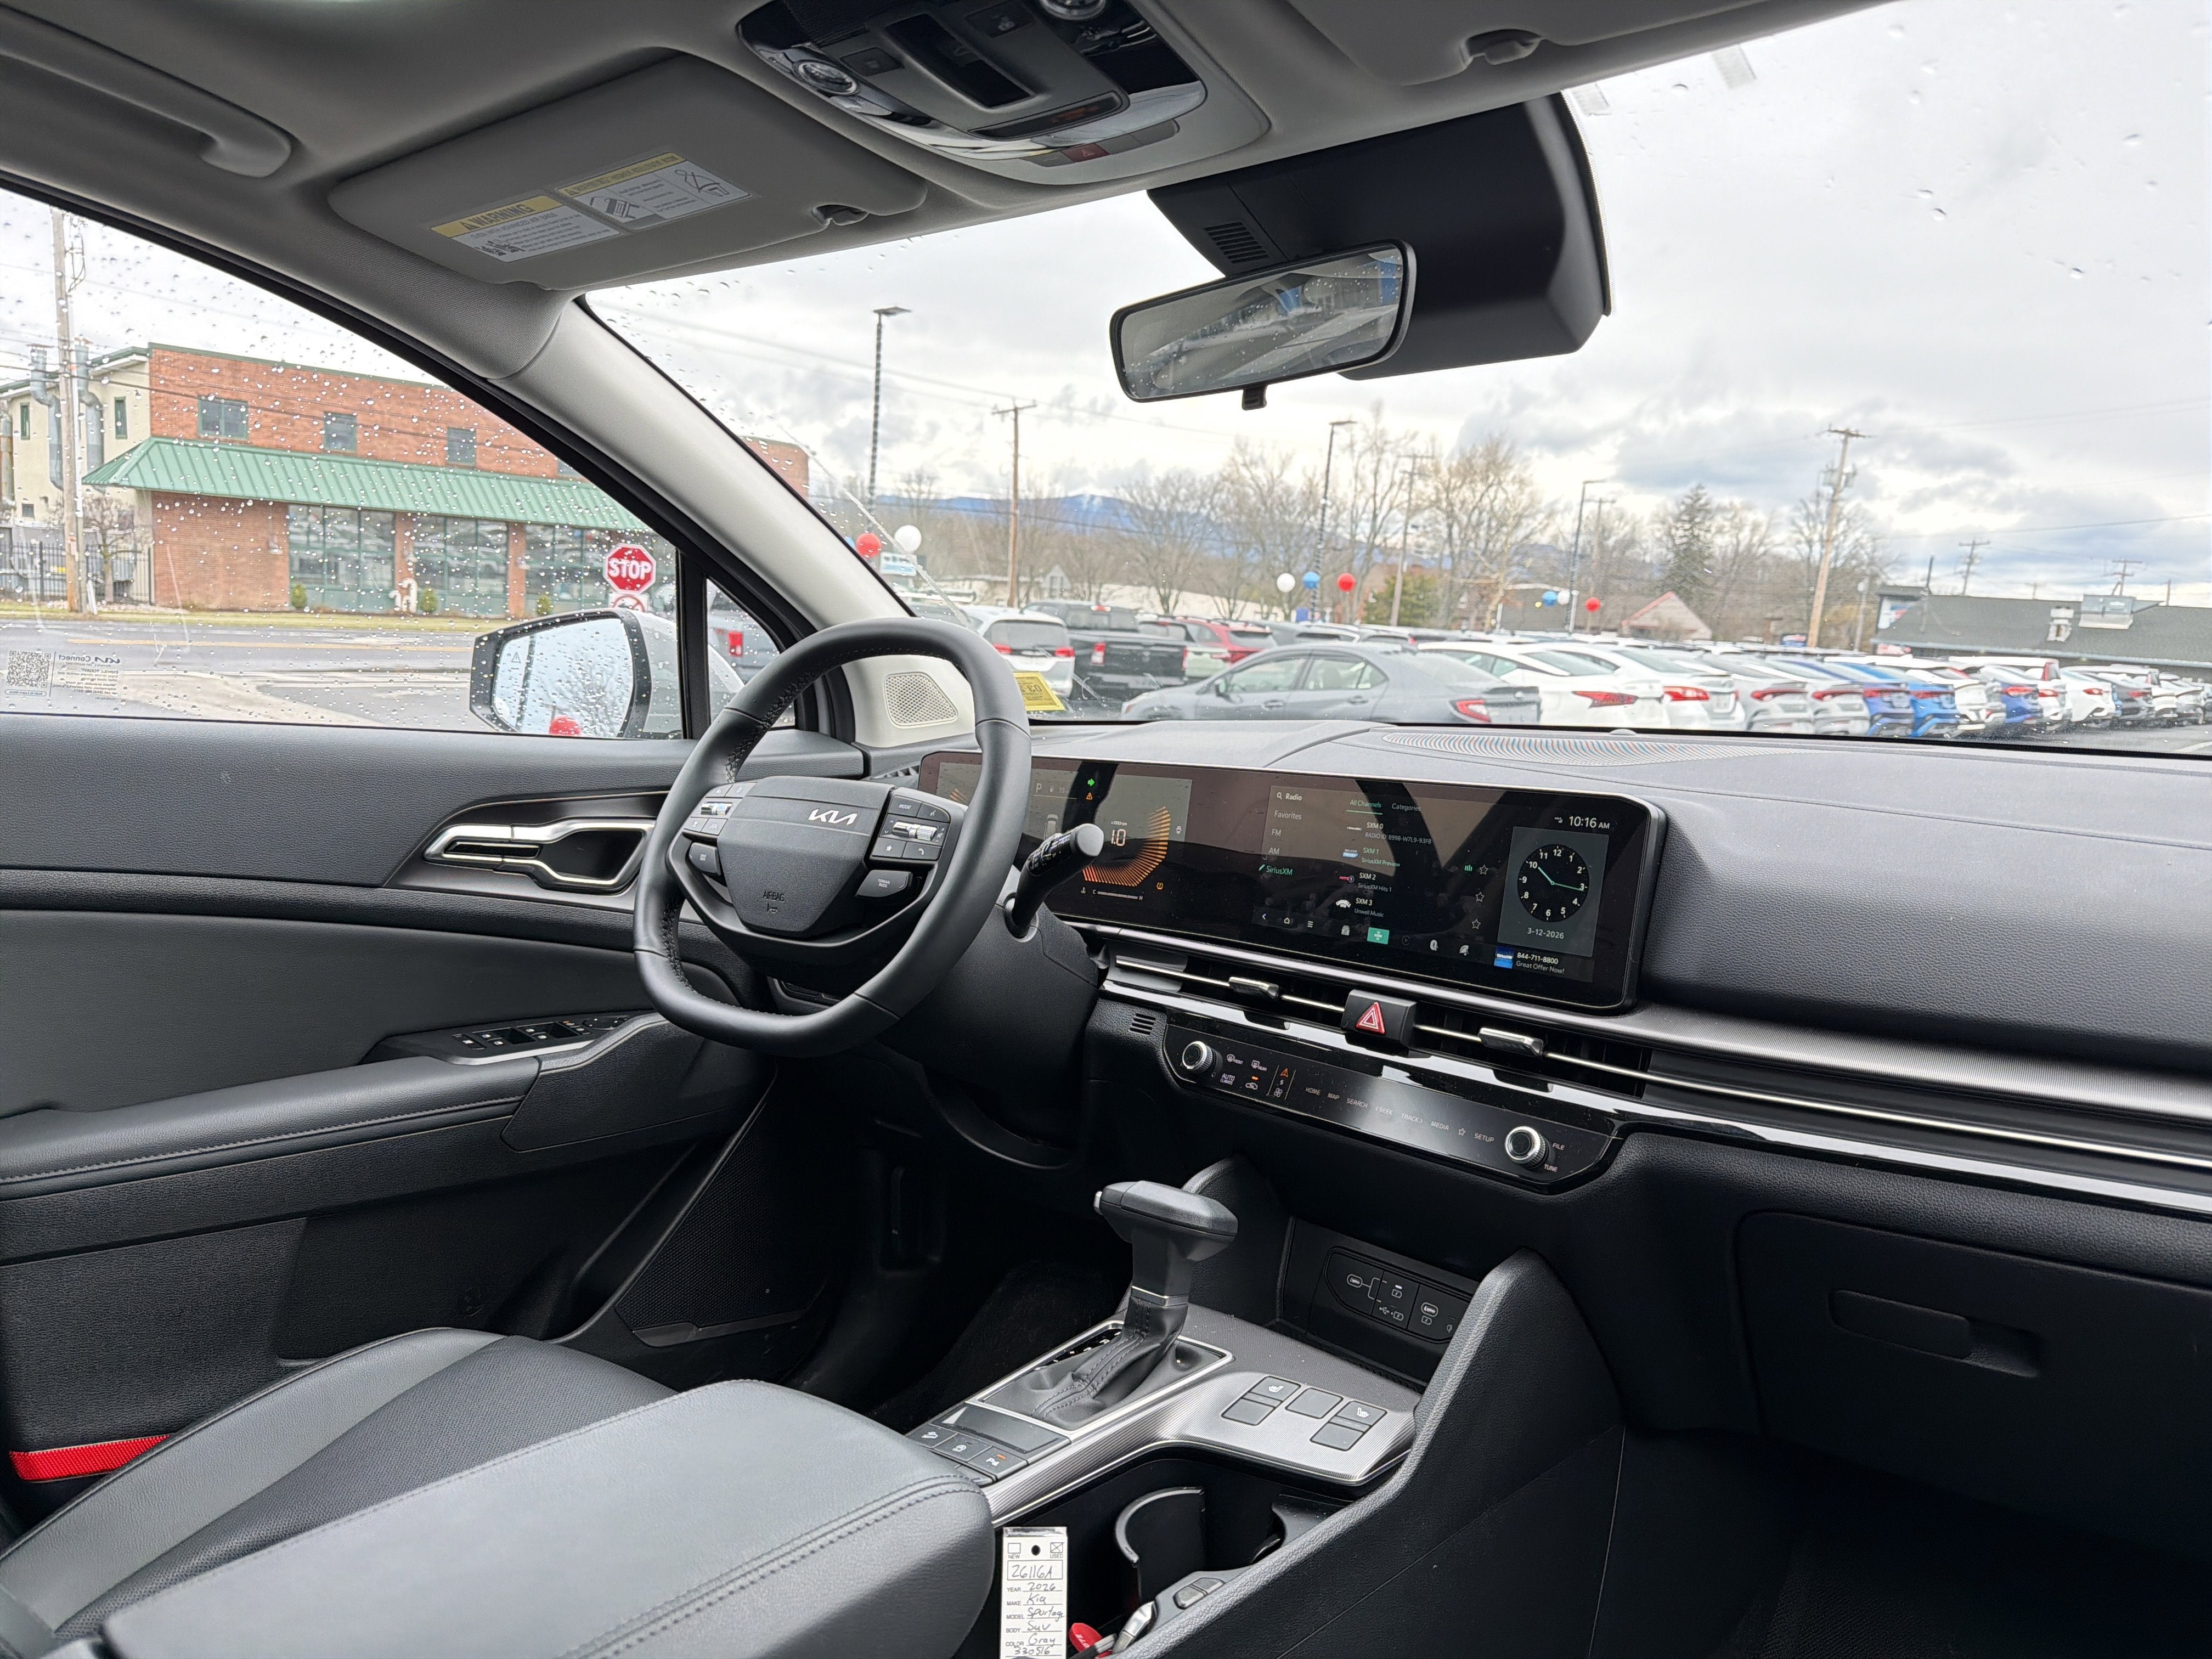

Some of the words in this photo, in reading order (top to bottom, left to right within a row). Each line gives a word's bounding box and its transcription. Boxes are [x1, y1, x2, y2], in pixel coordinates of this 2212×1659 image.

[471, 204, 534, 226] WARNING
[608, 557, 652, 580] STOP
[1036, 783, 1042, 793] P
[1285, 793, 1302, 801] Radio
[1357, 800, 1383, 809] Channels
[1391, 803, 1421, 812] Categories
[1274, 810, 1302, 820] Favorites
[1568, 816, 1597, 828] 10:16
[1111, 828, 1126, 847] 1.0
[1271, 828, 1282, 837] FM
[1268, 847, 1280, 855] AM
[1539, 851, 1548, 860] 11
[1553, 849, 1562, 857] 12
[1361, 857, 1382, 865] SiriusXM
[1382, 859, 1401, 867] Preview
[1568, 855, 1573, 863] 1
[1528, 861, 1538, 869] 10
[1266, 865, 1293, 876] SiriusXM
[1358, 882, 1378, 891] SiriusXM
[763, 890, 785, 902] AIRBAG
[1370, 909, 1385, 918] Music
[1527, 928, 1564, 939] 3-12-2026
[1517, 952, 1559, 965] 844-711-8800
[1516, 961, 1532, 969] Great
[1533, 963, 1549, 972] Offer
[1549, 966, 1565, 974] Now!
[1221, 1073, 1235, 1082] AUTO
[1305, 1086, 1322, 1096] HOME
[1327, 1092, 1340, 1101] MAP
[1346, 1097, 1368, 1109] SEARCH
[1378, 1107, 1393, 1115] SEEK
[1401, 1113, 1419, 1123] TRACK
[1430, 1120, 1449, 1131] MEDIA
[1474, 1132, 1494, 1143] SETUP
[1552, 1142, 1566, 1151] FILE
[1544, 1163, 1559, 1173] TUNE
[1011, 1564, 1053, 1579] 26116A
[1027, 1582, 1056, 1592] 2026
[1026, 1592, 1047, 1605] Kia
[1027, 1606, 1065, 1622] Sportage
[1028, 1633, 1056, 1647] Gray
[1014, 1646, 1051, 1655] 330516
